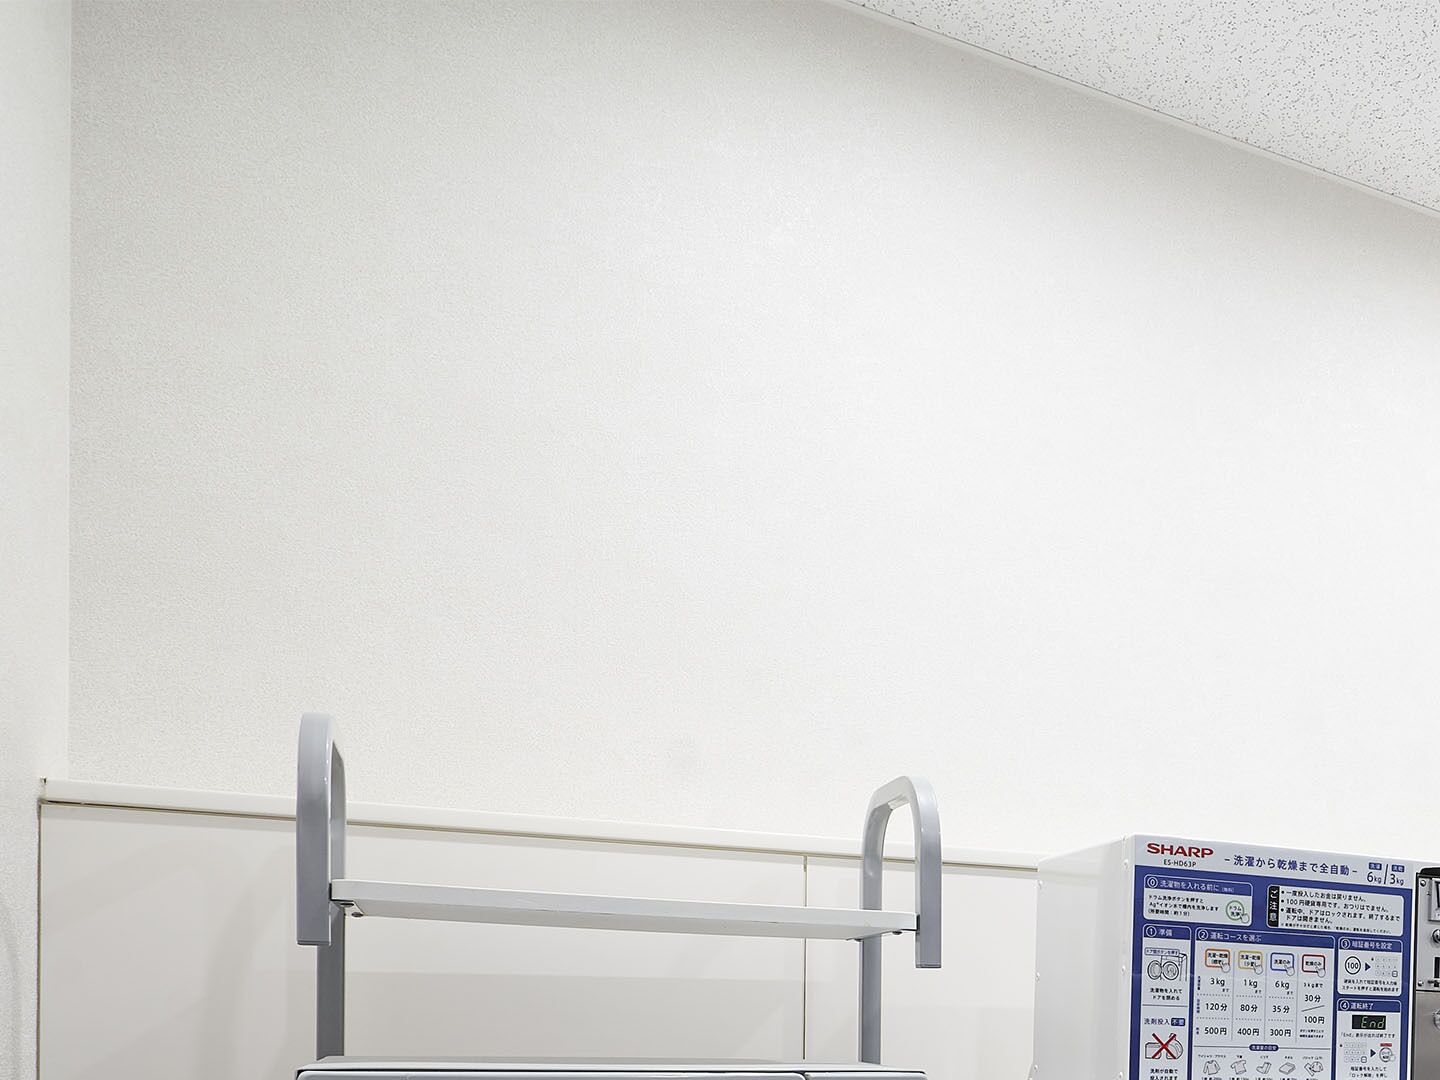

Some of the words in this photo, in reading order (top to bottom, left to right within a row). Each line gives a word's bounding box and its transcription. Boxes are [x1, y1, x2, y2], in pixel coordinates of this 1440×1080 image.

[1147, 843, 1213, 858] SHARP
[1164, 859, 1196, 867] ES-HD63P
[1367, 872, 1381, 884] 6kg
[1390, 873, 1404, 886] 3kg
[1305, 995, 1321, 1003] 30分
[1205, 1003, 1227, 1011] 120分
[1240, 1004, 1258, 1012] 80分
[1272, 1005, 1290, 1013] 35分
[1304, 1016, 1325, 1024] 100円
[1361, 1016, 1385, 1028] End
[1204, 1027, 1227, 1035] 500円
[1237, 1028, 1259, 1036] 400円
[1270, 1029, 1291, 1037] 300円
